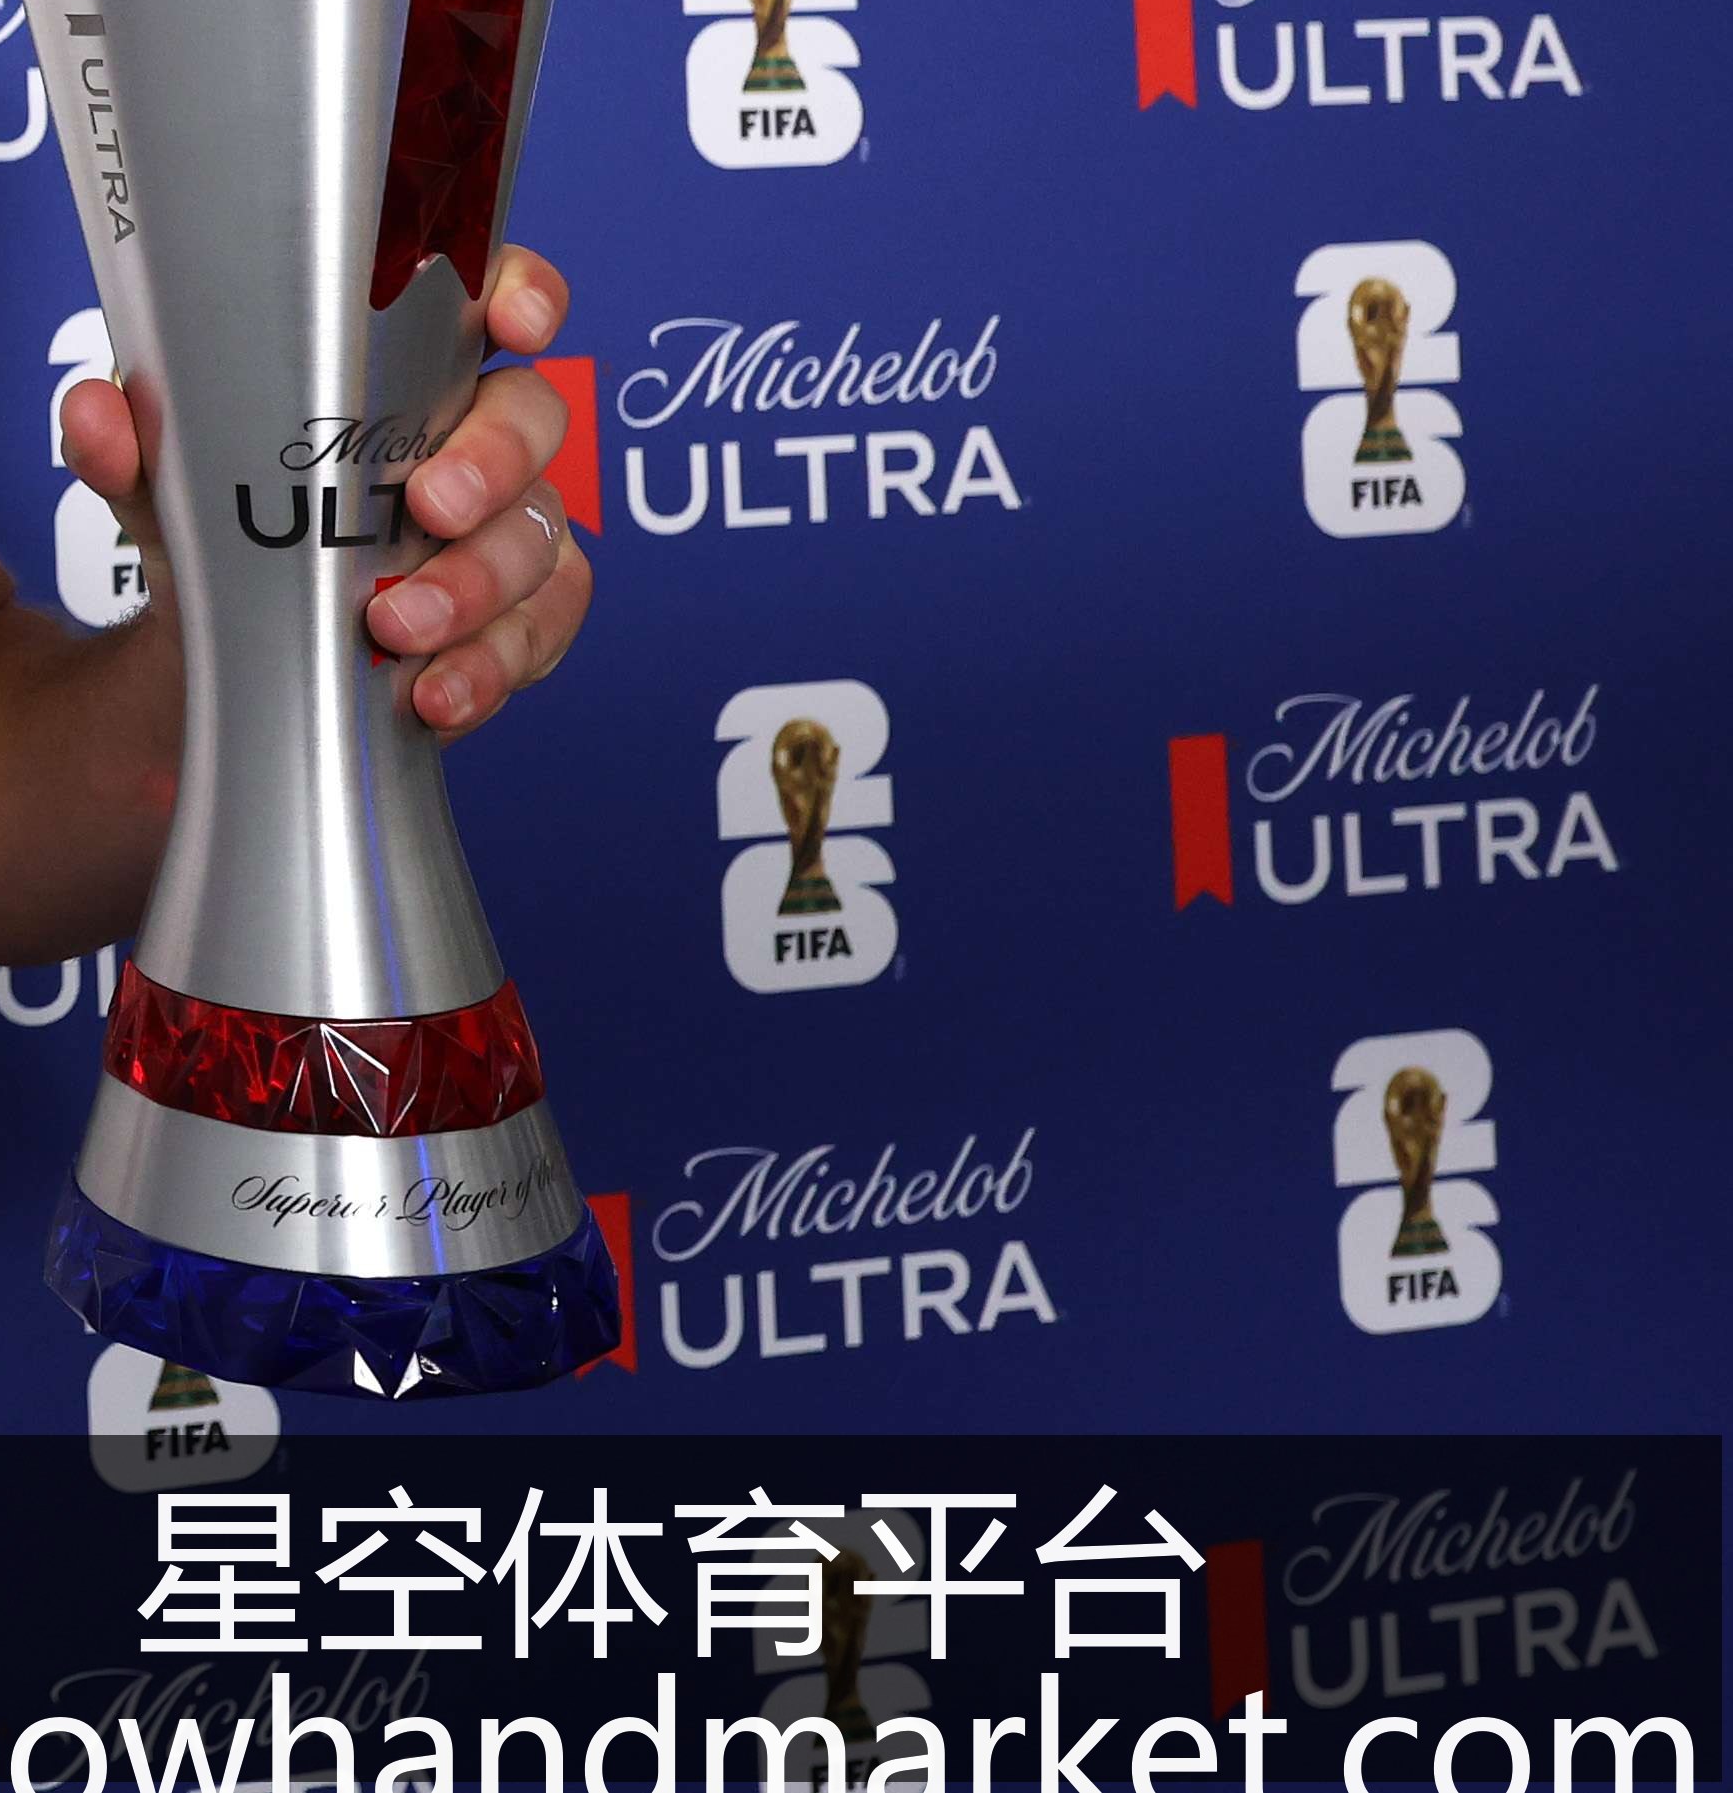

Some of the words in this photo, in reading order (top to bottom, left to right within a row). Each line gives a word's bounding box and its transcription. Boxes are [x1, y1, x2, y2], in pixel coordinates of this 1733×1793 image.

[1216, 14, 1582, 110] ULTRA
[80, 58, 136, 244] ULTRA
[738, 106, 817, 139] FIFA
[617, 313, 1000, 429] Michelob
[235, 483, 433, 549] ULT
[625, 426, 1022, 535] ULTRA
[1350, 476, 1423, 510] FIFA
[1247, 683, 1598, 802] Michelob
[1254, 792, 1618, 904] ULTRA
[773, 926, 853, 964] FIFA
[395, 1176, 507, 1231] Player
[653, 1127, 1035, 1262] Michelob
[660, 1240, 1057, 1369] ULTRA
[1385, 1267, 1461, 1305] FIFA
[144, 1419, 231, 1462] FIFA
[1285, 1468, 1636, 1606] Michelob
[1291, 1578, 1659, 1708] ULTRA
